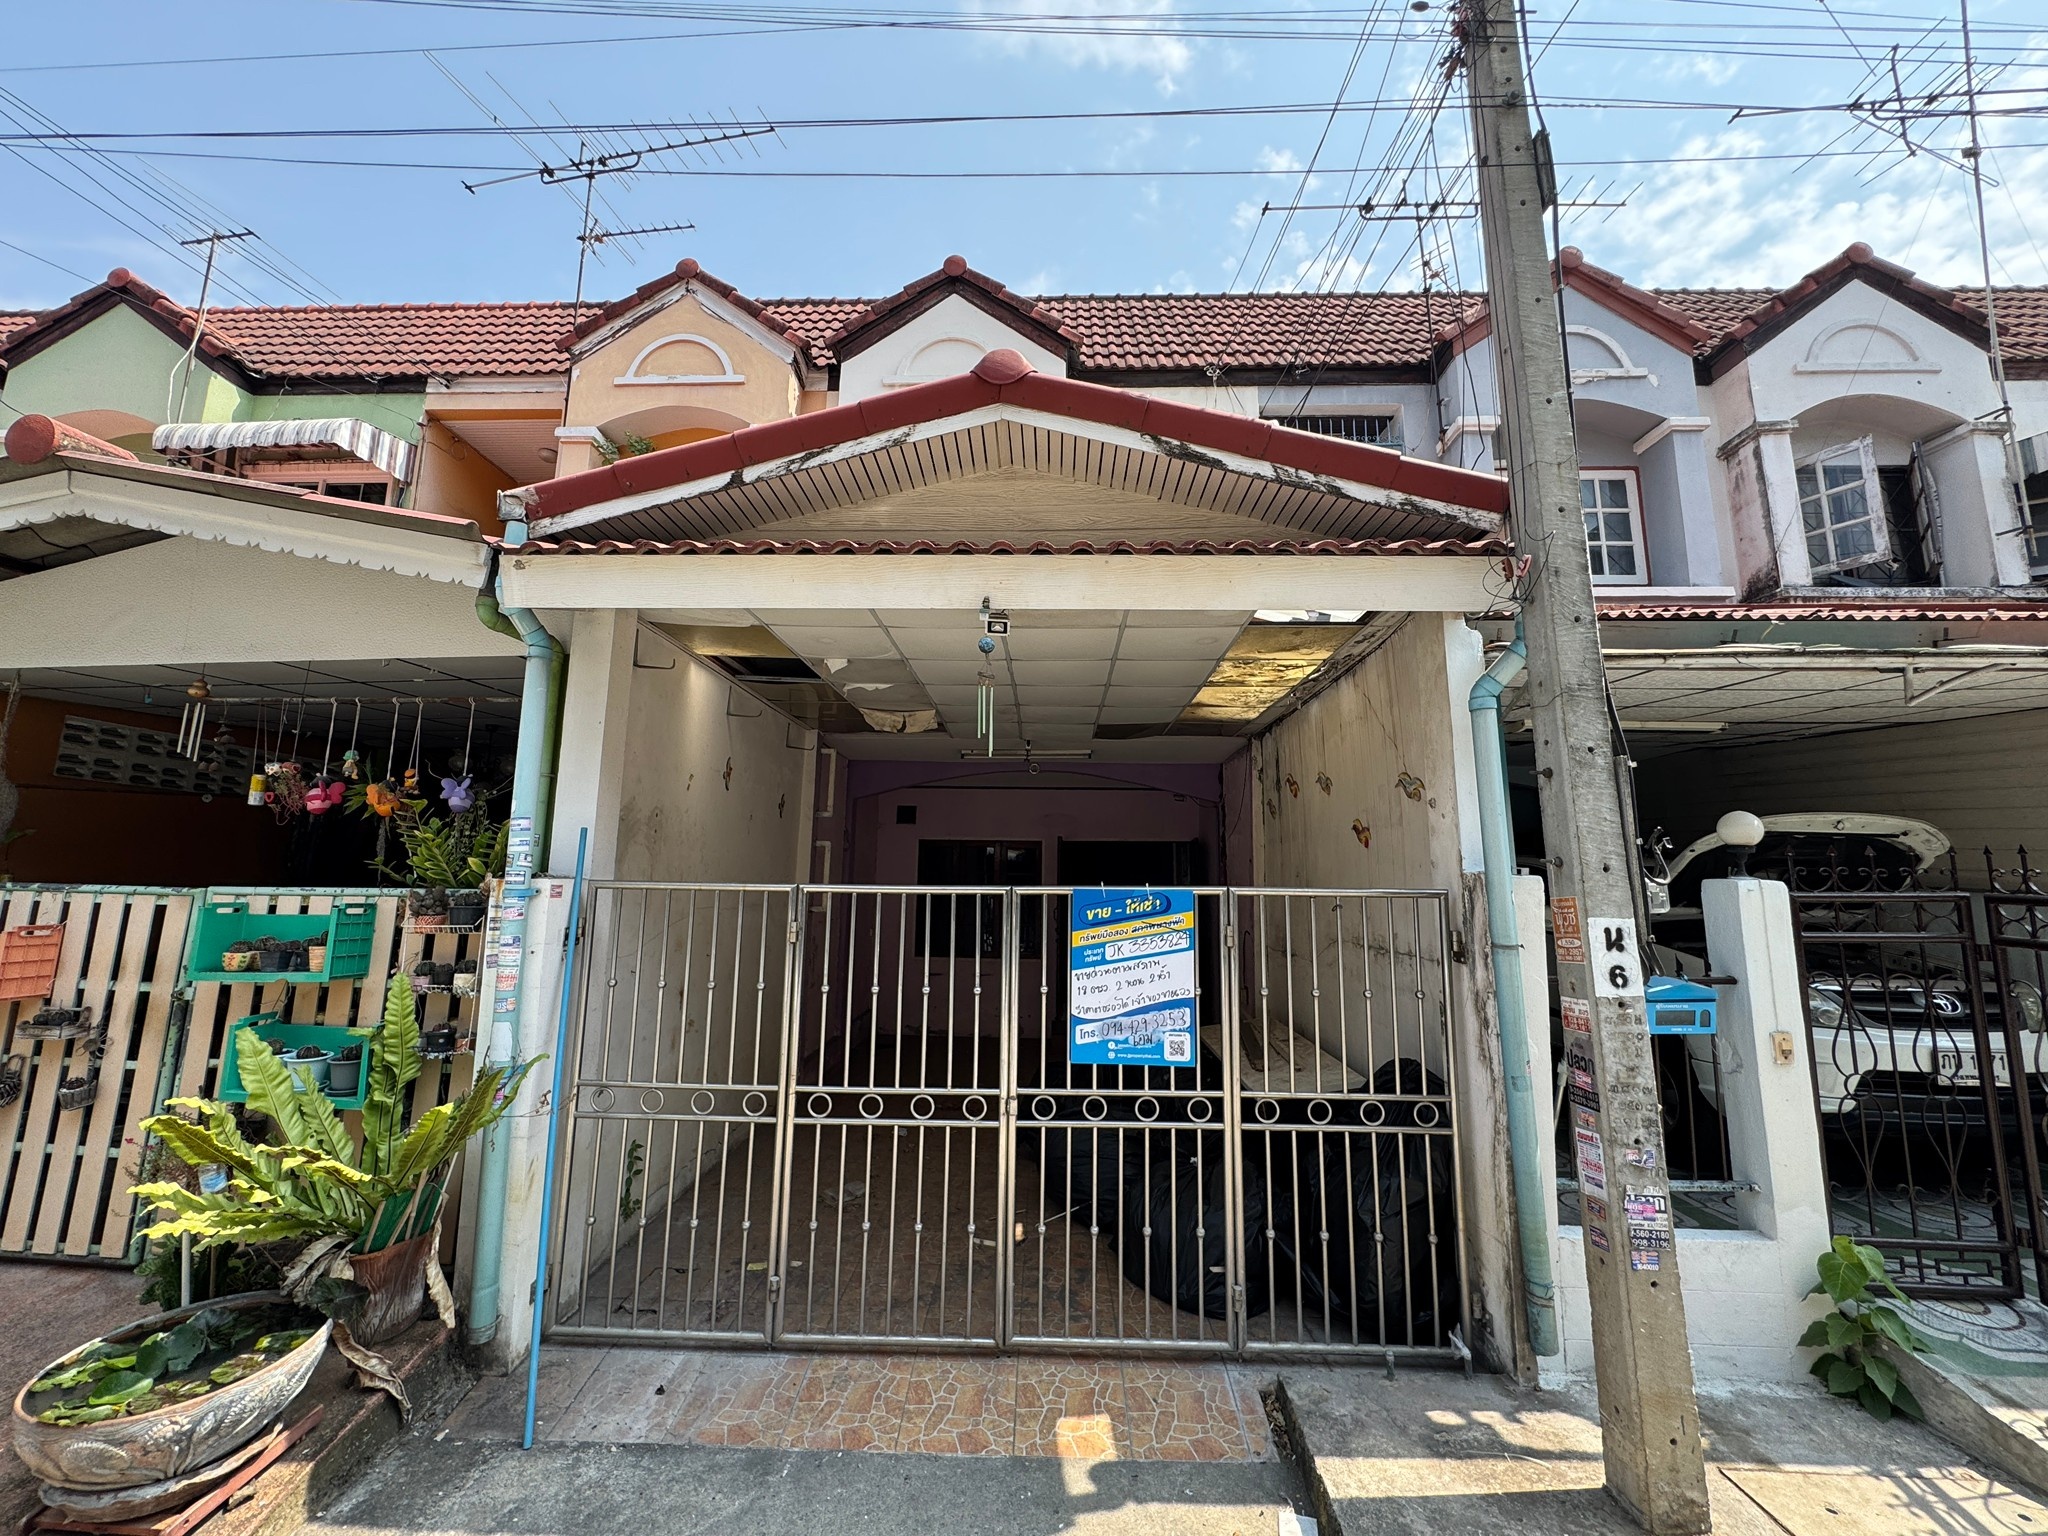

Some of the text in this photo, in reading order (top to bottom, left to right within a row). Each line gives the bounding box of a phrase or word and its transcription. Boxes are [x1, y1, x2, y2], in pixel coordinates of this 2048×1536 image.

[1086, 906, 1112, 920] ขาย
[1079, 927, 1129, 943] ทรัพย์มือสอง
[1108, 943, 1125, 958] JK
[1115, 981, 1123, 991] 2
[1149, 973, 1156, 984] 2
[1609, 965, 1628, 989] 6
[1079, 1028, 1099, 1040] โทร.
